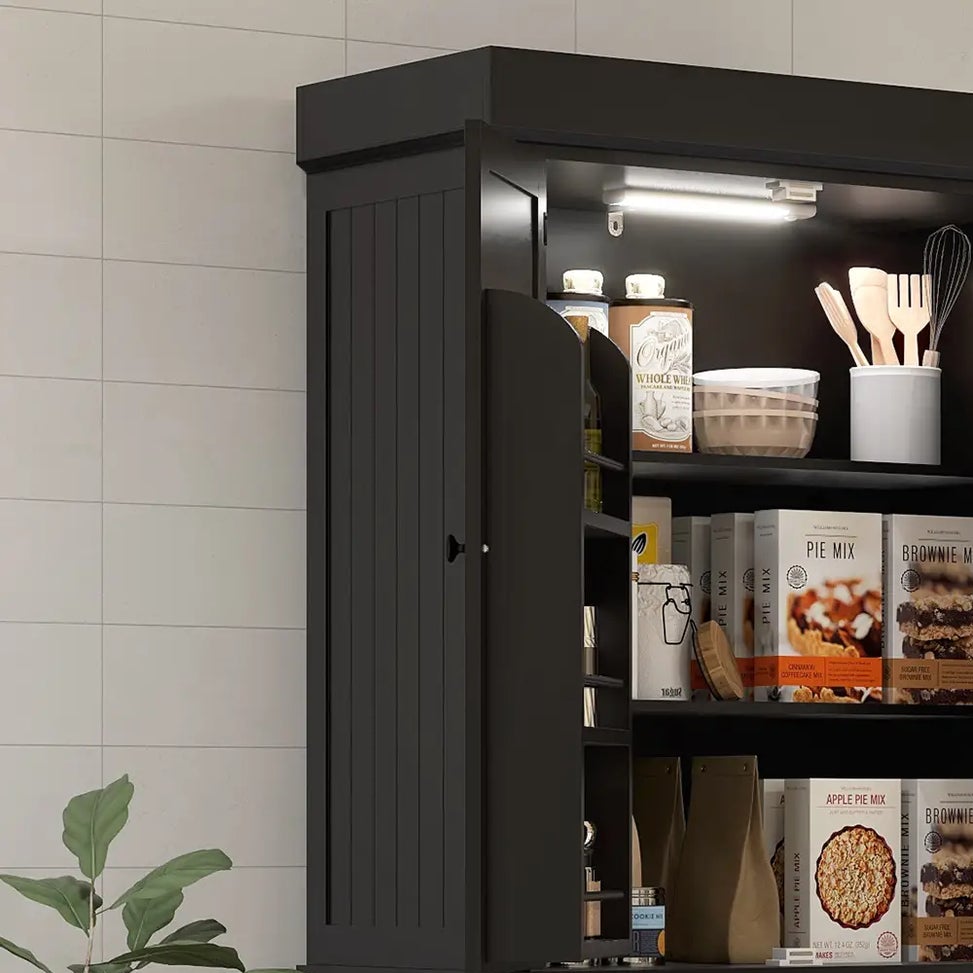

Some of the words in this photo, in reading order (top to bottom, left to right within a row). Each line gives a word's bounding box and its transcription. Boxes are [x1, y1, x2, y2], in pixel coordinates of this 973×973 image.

[636, 373, 672, 384] WHOLE
[806, 541, 826, 559] PIE
[833, 542, 855, 560] MIX
[902, 545, 957, 564] BROWNIE
[719, 570, 727, 596] MIX
[762, 568, 771, 593] MIX
[719, 604, 727, 626] PIE
[762, 602, 771, 624] PIE
[826, 794, 853, 805] APPLE
[855, 794, 868, 805] PIE
[870, 794, 886, 805] MIX
[901, 813, 909, 837] MIX
[925, 807, 973, 824] BROWNIE
[900, 844, 909, 908] BROWNIE
